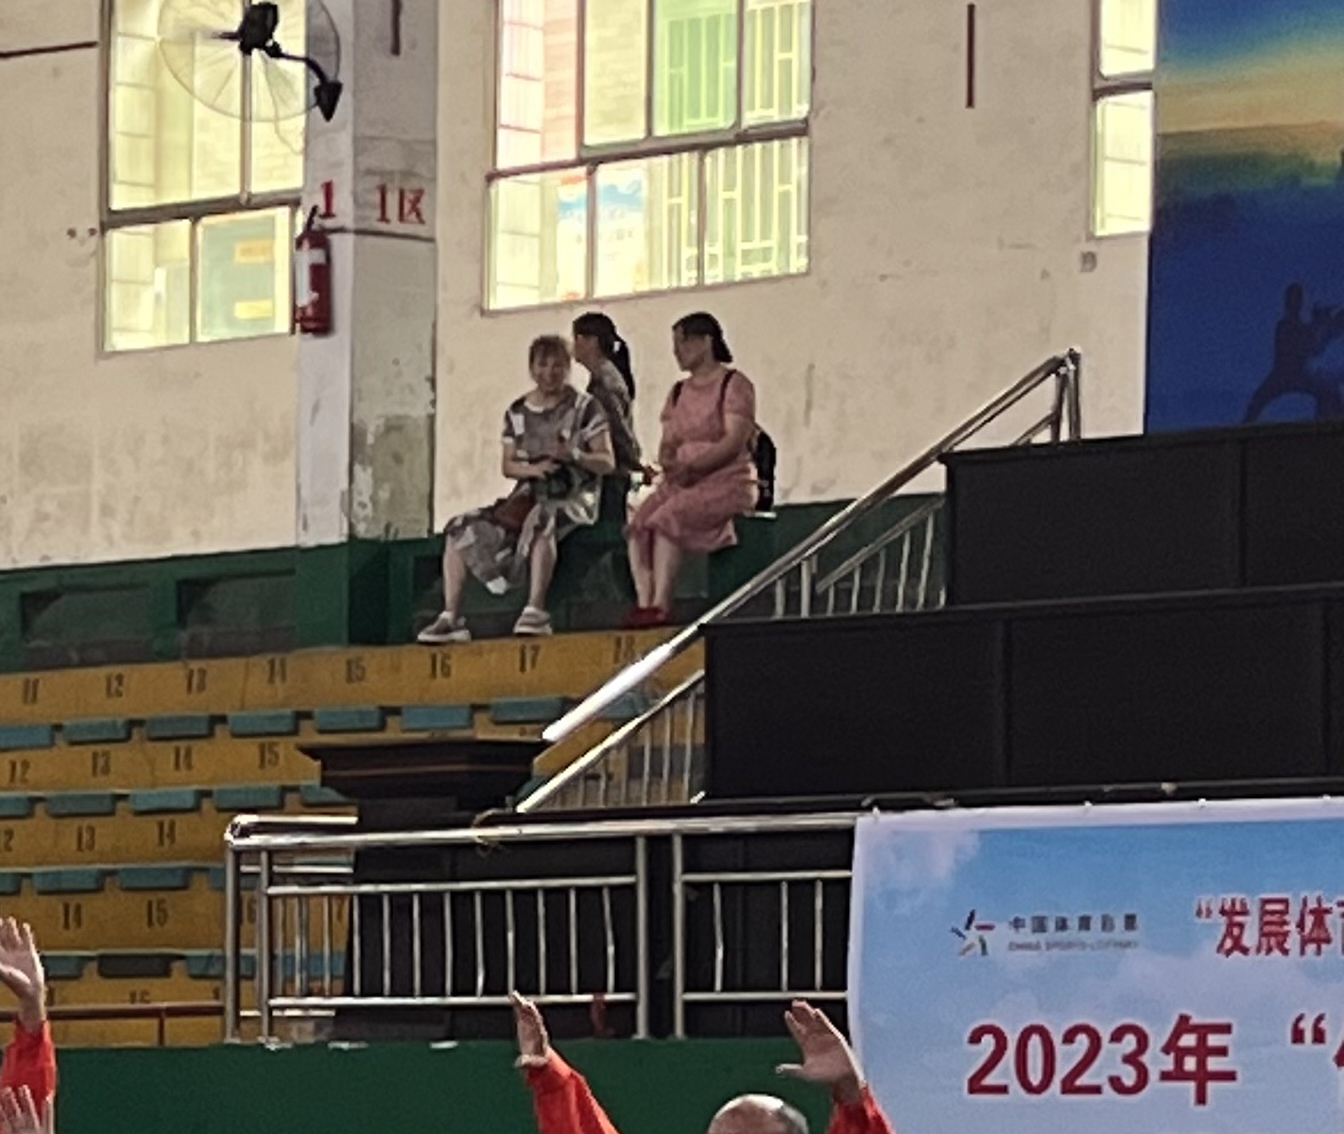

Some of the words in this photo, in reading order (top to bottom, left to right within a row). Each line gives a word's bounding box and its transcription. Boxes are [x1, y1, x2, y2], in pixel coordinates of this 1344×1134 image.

[1196, 896, 1344, 957] “发展体
[967, 1014, 1344, 1105] 2023年“
